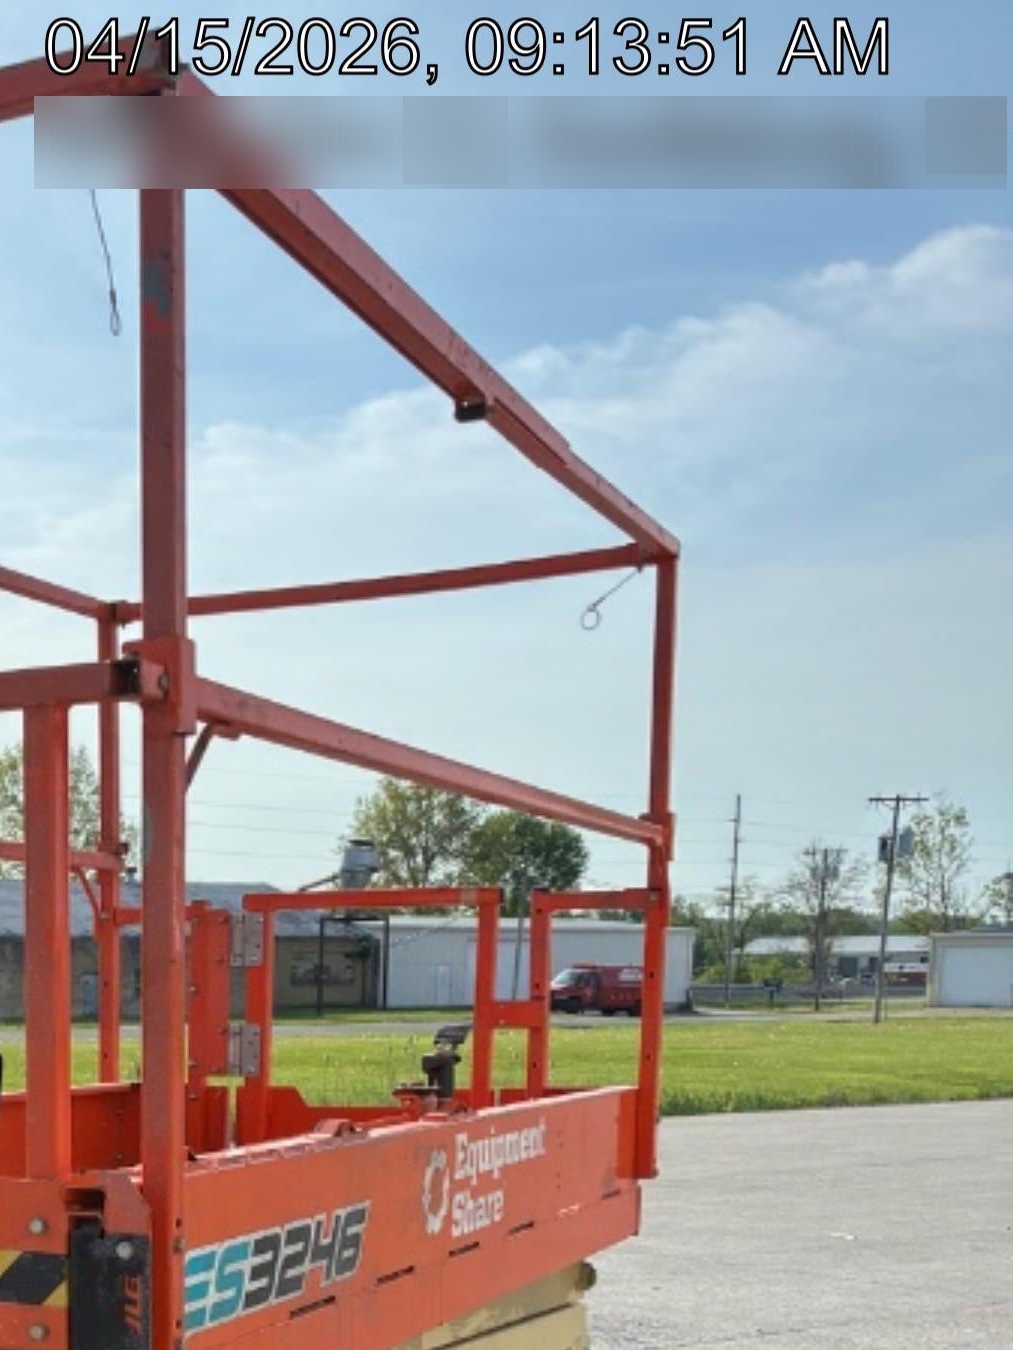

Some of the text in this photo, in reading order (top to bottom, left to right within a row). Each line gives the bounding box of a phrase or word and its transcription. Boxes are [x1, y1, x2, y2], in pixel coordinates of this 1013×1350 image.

[454, 1120, 547, 1186] Equipment
[451, 1188, 505, 1238] Share
[183, 1199, 372, 1335] ES3246
